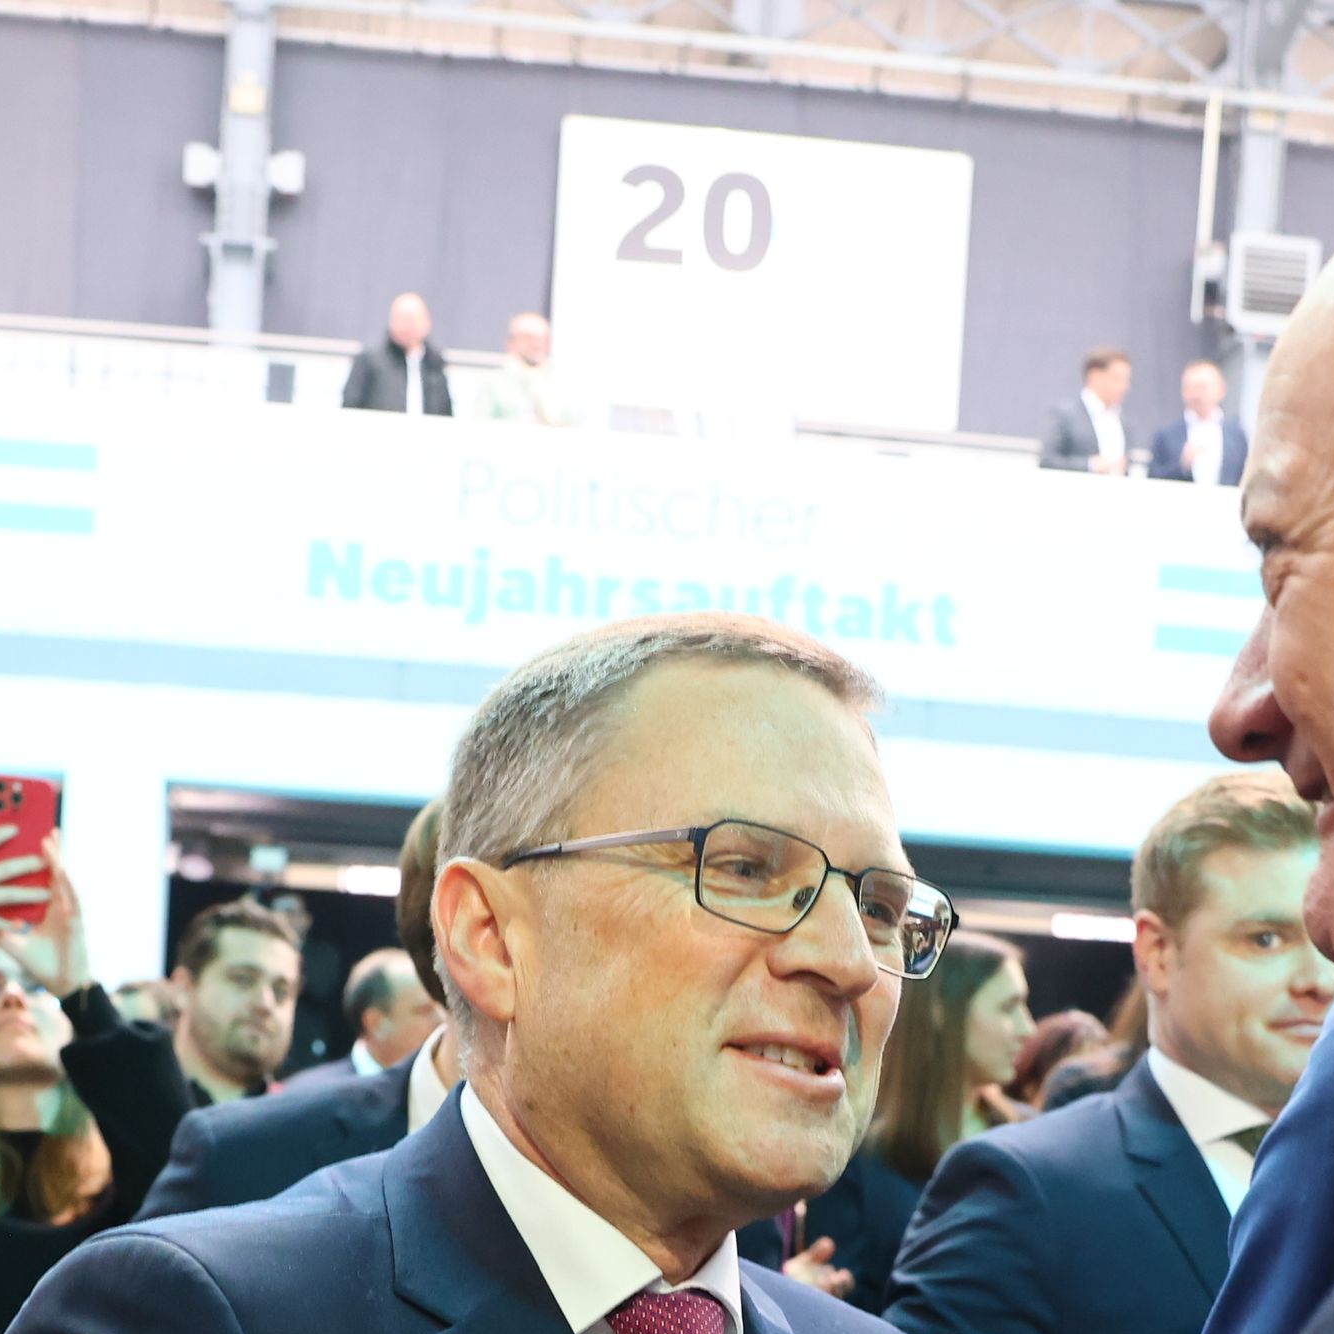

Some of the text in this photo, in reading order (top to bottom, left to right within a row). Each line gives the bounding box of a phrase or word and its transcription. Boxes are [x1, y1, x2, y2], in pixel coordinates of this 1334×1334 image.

[616, 164, 773, 272] 20
[457, 456, 820, 547] Politischer
[304, 539, 959, 648] Neujahrsauftakt
